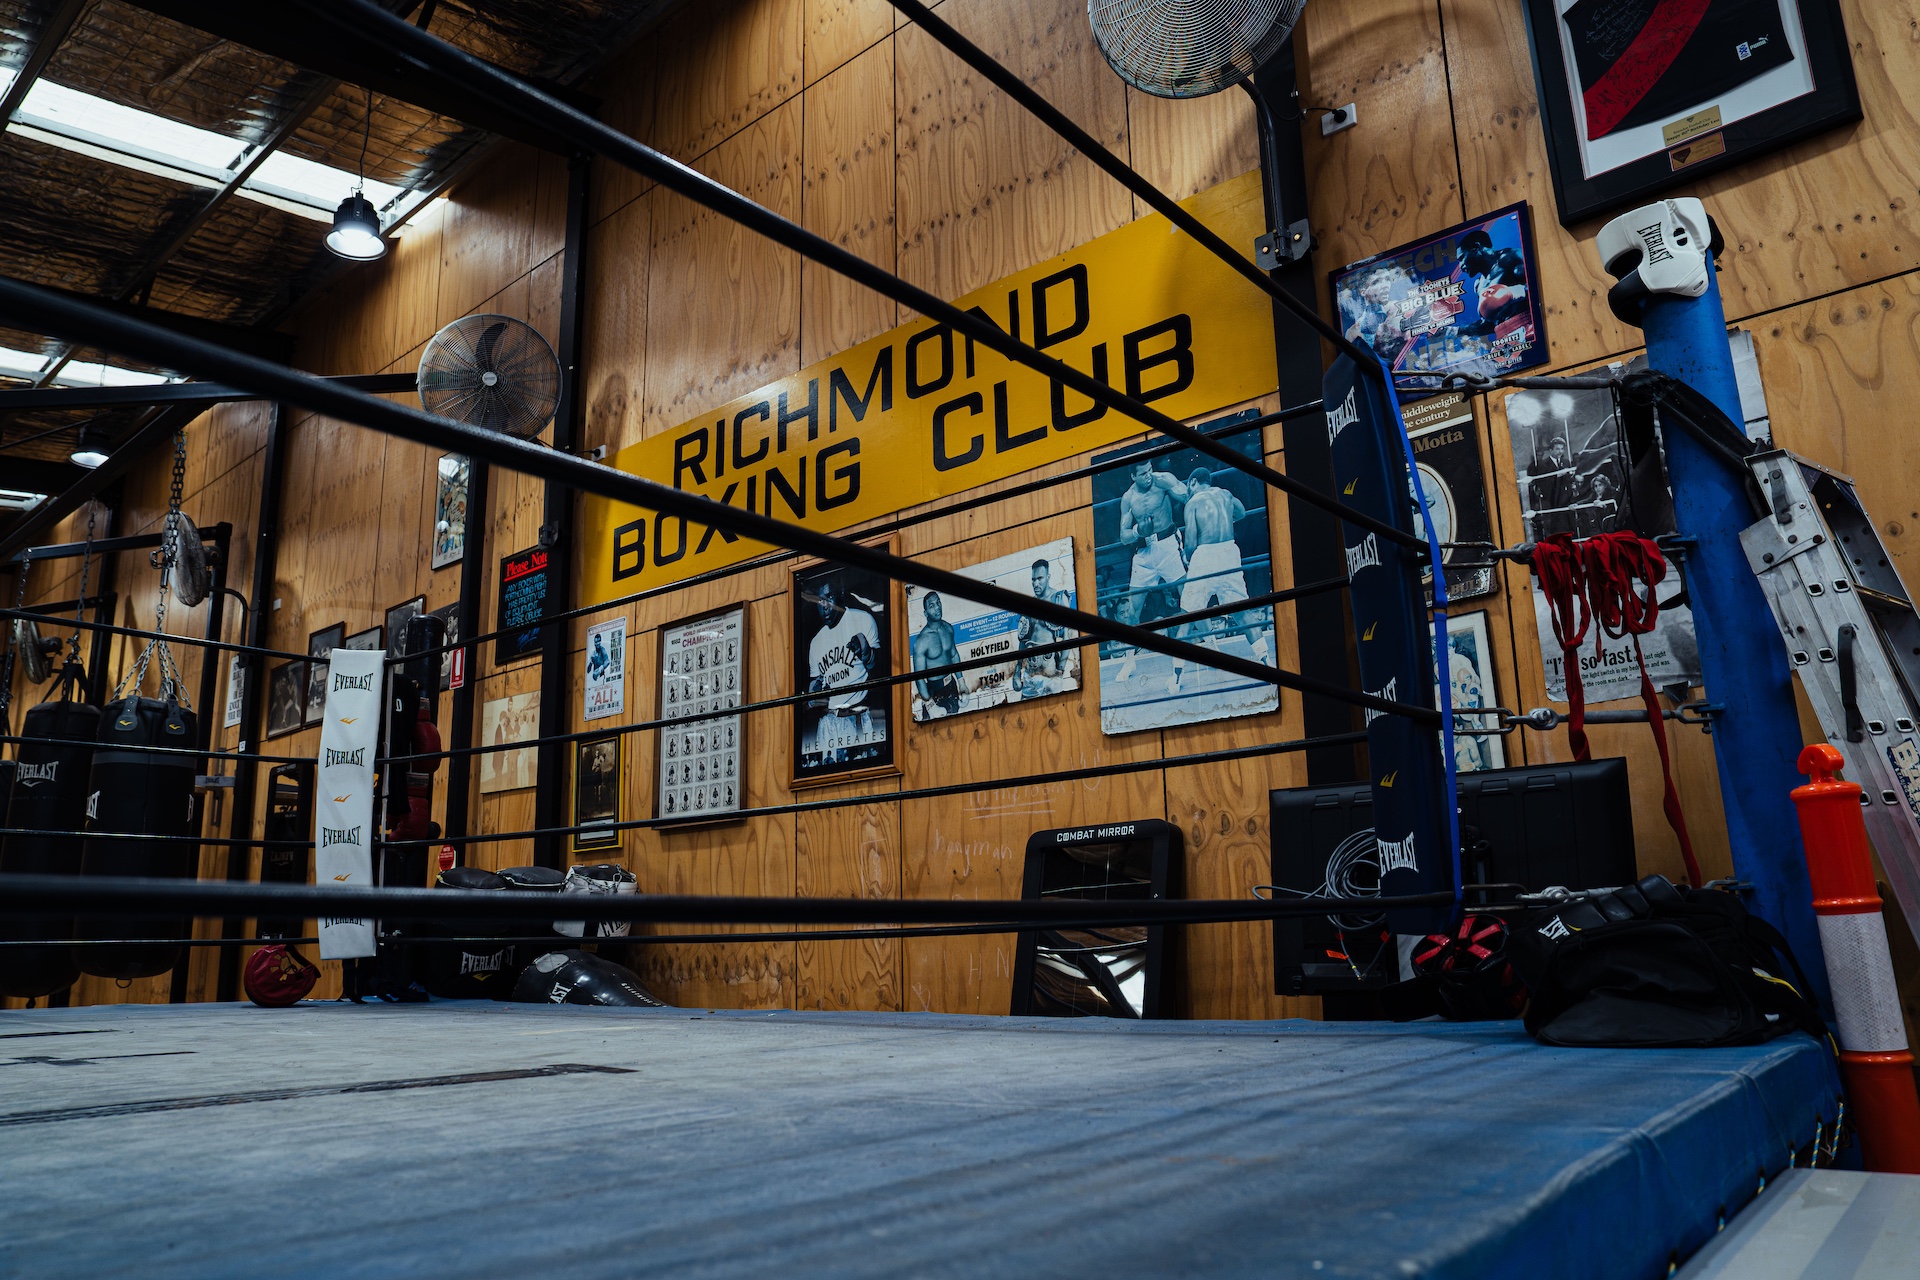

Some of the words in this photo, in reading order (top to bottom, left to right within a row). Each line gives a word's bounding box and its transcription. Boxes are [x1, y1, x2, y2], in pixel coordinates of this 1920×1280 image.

[1637, 222, 1674, 266] EVERLAST
[1401, 298, 1423, 313] BIG
[1426, 284, 1460, 304] BLUE
[1407, 288, 1419, 298] THE
[672, 263, 1090, 491] RICHMOND
[1326, 386, 1359, 447] EVERLAST
[1403, 420, 1414, 429] he
[1415, 409, 1451, 425] century
[612, 437, 861, 582] BOXING
[932, 313, 1194, 472] CLUB
[1413, 430, 1464, 454] Motta
[506, 561, 529, 578] Please
[1345, 532, 1380, 584] EVERLAST
[818, 645, 857, 675] ONSDALE
[970, 641, 1010, 658] HOLYFIELD
[1546, 657, 1565, 675] “I’
[1581, 656, 1598, 671] so
[1602, 645, 1633, 667] fast
[333, 672, 374, 692] EVERLAST
[979, 672, 1005, 686] TYSON
[594, 688, 613, 705] ALI
[805, 740, 819, 752] HE
[828, 729, 885, 748] GREATES
[325, 747, 366, 768] EVERLAST
[16, 761, 59, 782] EVERLAST
[322, 825, 362, 848] EVERLAST
[1056, 829, 1095, 842] COMBAT
[1098, 825, 1135, 837] MIRROR
[1377, 831, 1418, 878] EVERLAST
[460, 950, 503, 975] EVERLAST
